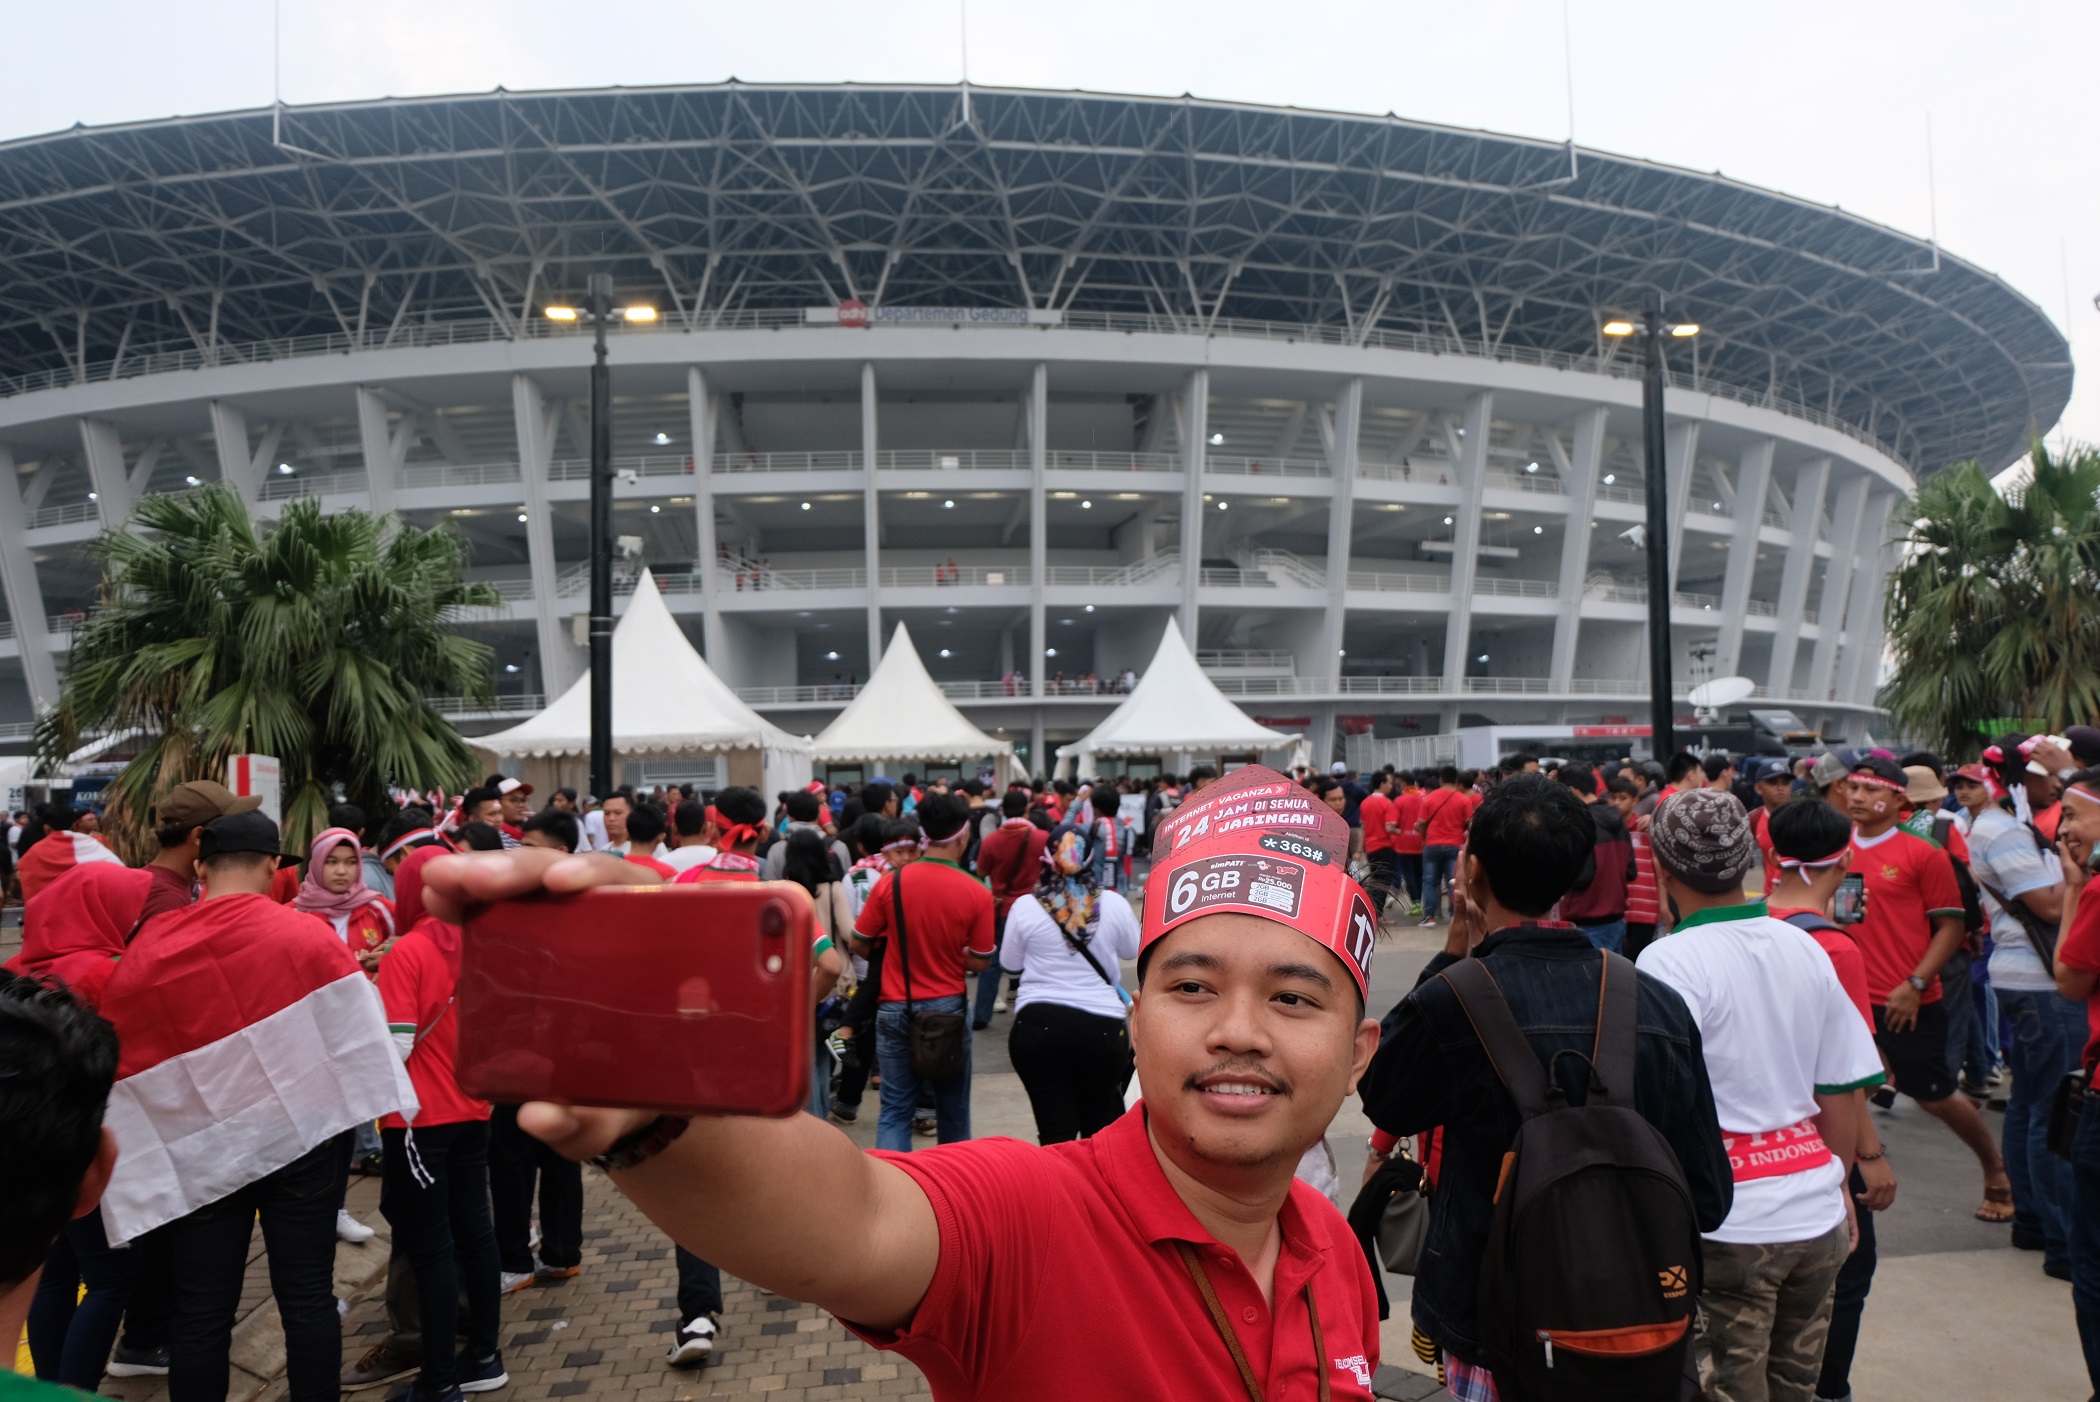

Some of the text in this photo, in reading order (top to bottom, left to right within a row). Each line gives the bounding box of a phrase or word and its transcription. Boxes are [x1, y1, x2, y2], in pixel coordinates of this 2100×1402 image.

[875, 307, 965, 321] Departemen
[969, 307, 1029, 325] Gedung
[1164, 787, 1273, 833] INTERNET VAGANZA
[1218, 813, 1315, 833] JARINGAN
[1175, 799, 1309, 850] 24 JAM DI SEMUA
[1210, 860, 1244, 870] simPATI
[1171, 870, 1241, 914] 6 GB
[1749, 1139, 1827, 1166] INDONES
